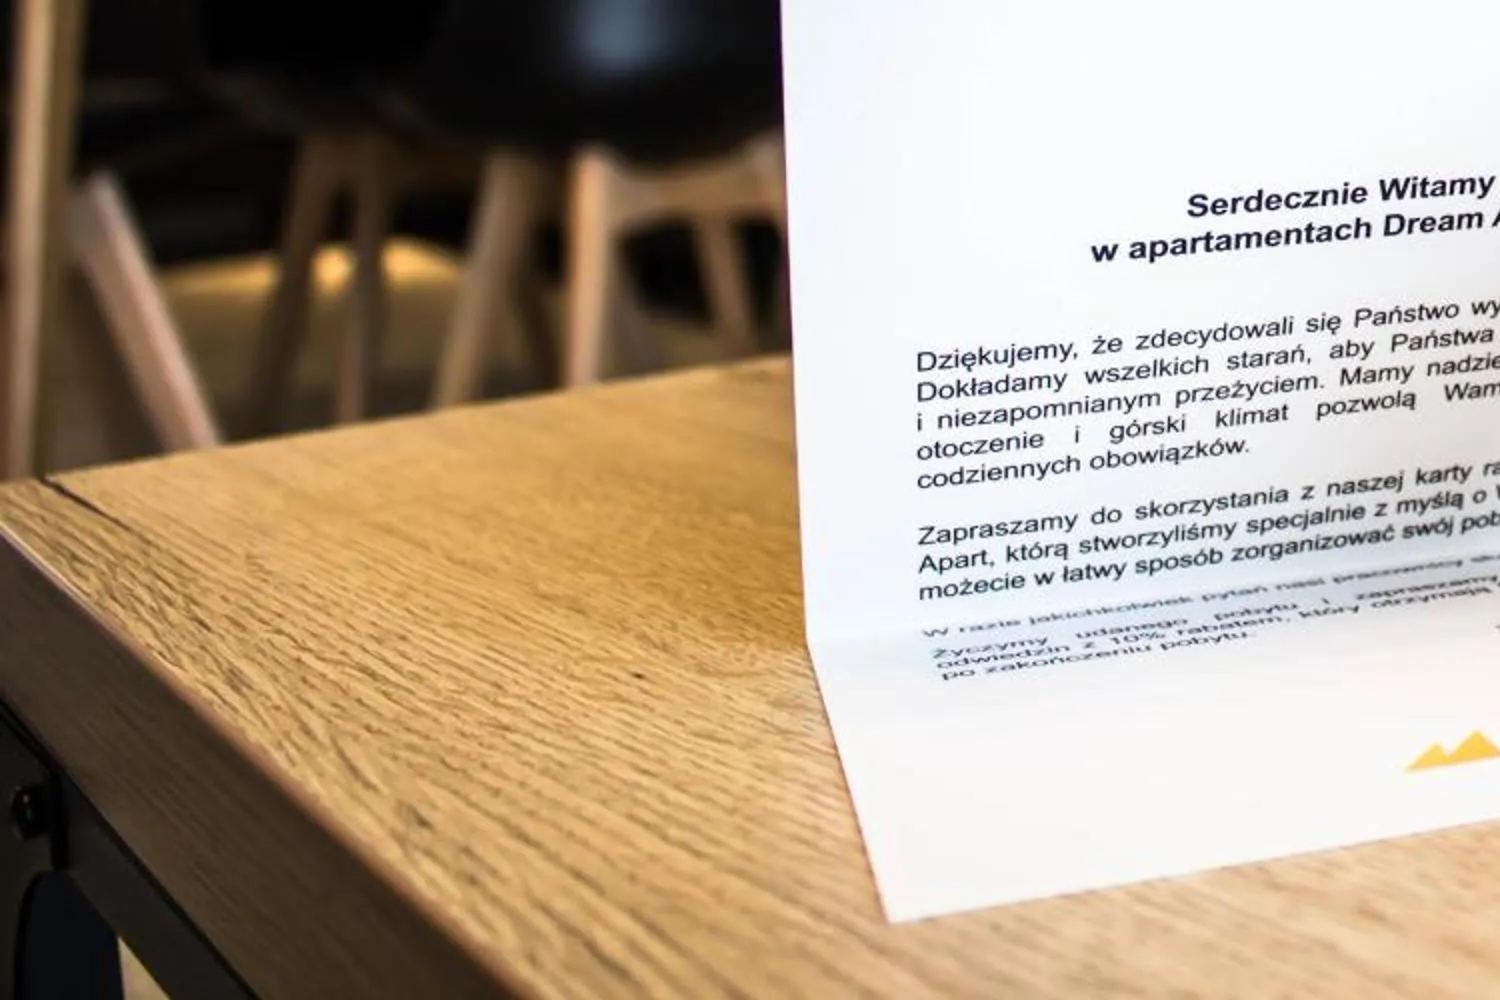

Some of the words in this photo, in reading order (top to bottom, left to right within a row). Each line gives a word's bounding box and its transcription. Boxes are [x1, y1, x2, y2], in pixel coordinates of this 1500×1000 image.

[1187, 182, 1368, 218] Serdecznie
[1379, 175, 1496, 202] Witamy
[1090, 243, 1119, 263] w
[1128, 217, 1372, 264] apartamentach
[1383, 211, 1484, 237] Dream
[917, 342, 1078, 373] Dziękujemy,
[1092, 335, 1123, 355] że
[1135, 316, 1294, 350] zdecydowali
[1305, 312, 1342, 336] się
[1353, 303, 1460, 328] Państwo
[917, 373, 1068, 403] Dokładamy
[1084, 355, 1209, 385] wszelkich
[1226, 344, 1311, 371] starań,
[1329, 339, 1376, 361] aby
[1390, 328, 1495, 353] Państwa
[917, 412, 922, 432] i
[937, 392, 1161, 430] niezapomnianym
[1175, 375, 1325, 409] przeżyciem.
[1340, 365, 1415, 387] Mamy
[917, 431, 1045, 461] otoczenie
[1075, 425, 1080, 444] i
[1109, 413, 1186, 445] górski
[1215, 404, 1289, 429] klimat
[1316, 390, 1416, 422] pozwolą
[917, 455, 1081, 489] codziennych
[1089, 437, 1249, 470] obowiązków.
[917, 513, 1079, 547] Zapraszamy
[1090, 506, 1123, 525] do
[1135, 486, 1289, 521] skorzystania
[1300, 485, 1315, 501] z
[1326, 470, 1405, 497] naszej
[1415, 464, 1473, 486] karty
[918, 549, 995, 576] Apart,
[1005, 541, 1069, 564] którą
[1078, 521, 1239, 555] stworzyliśmy
[1245, 503, 1367, 537] specjalnie
[1373, 502, 1388, 517] z
[1395, 490, 1465, 517] myślą
[1471, 489, 1488, 504] o
[919, 572, 1026, 601] możecie
[1033, 571, 1056, 587] w
[1061, 562, 1127, 583] łatwy
[1134, 547, 1224, 577] sposób
[1230, 523, 1396, 562] zorganizować
[1401, 515, 1454, 540] swój
